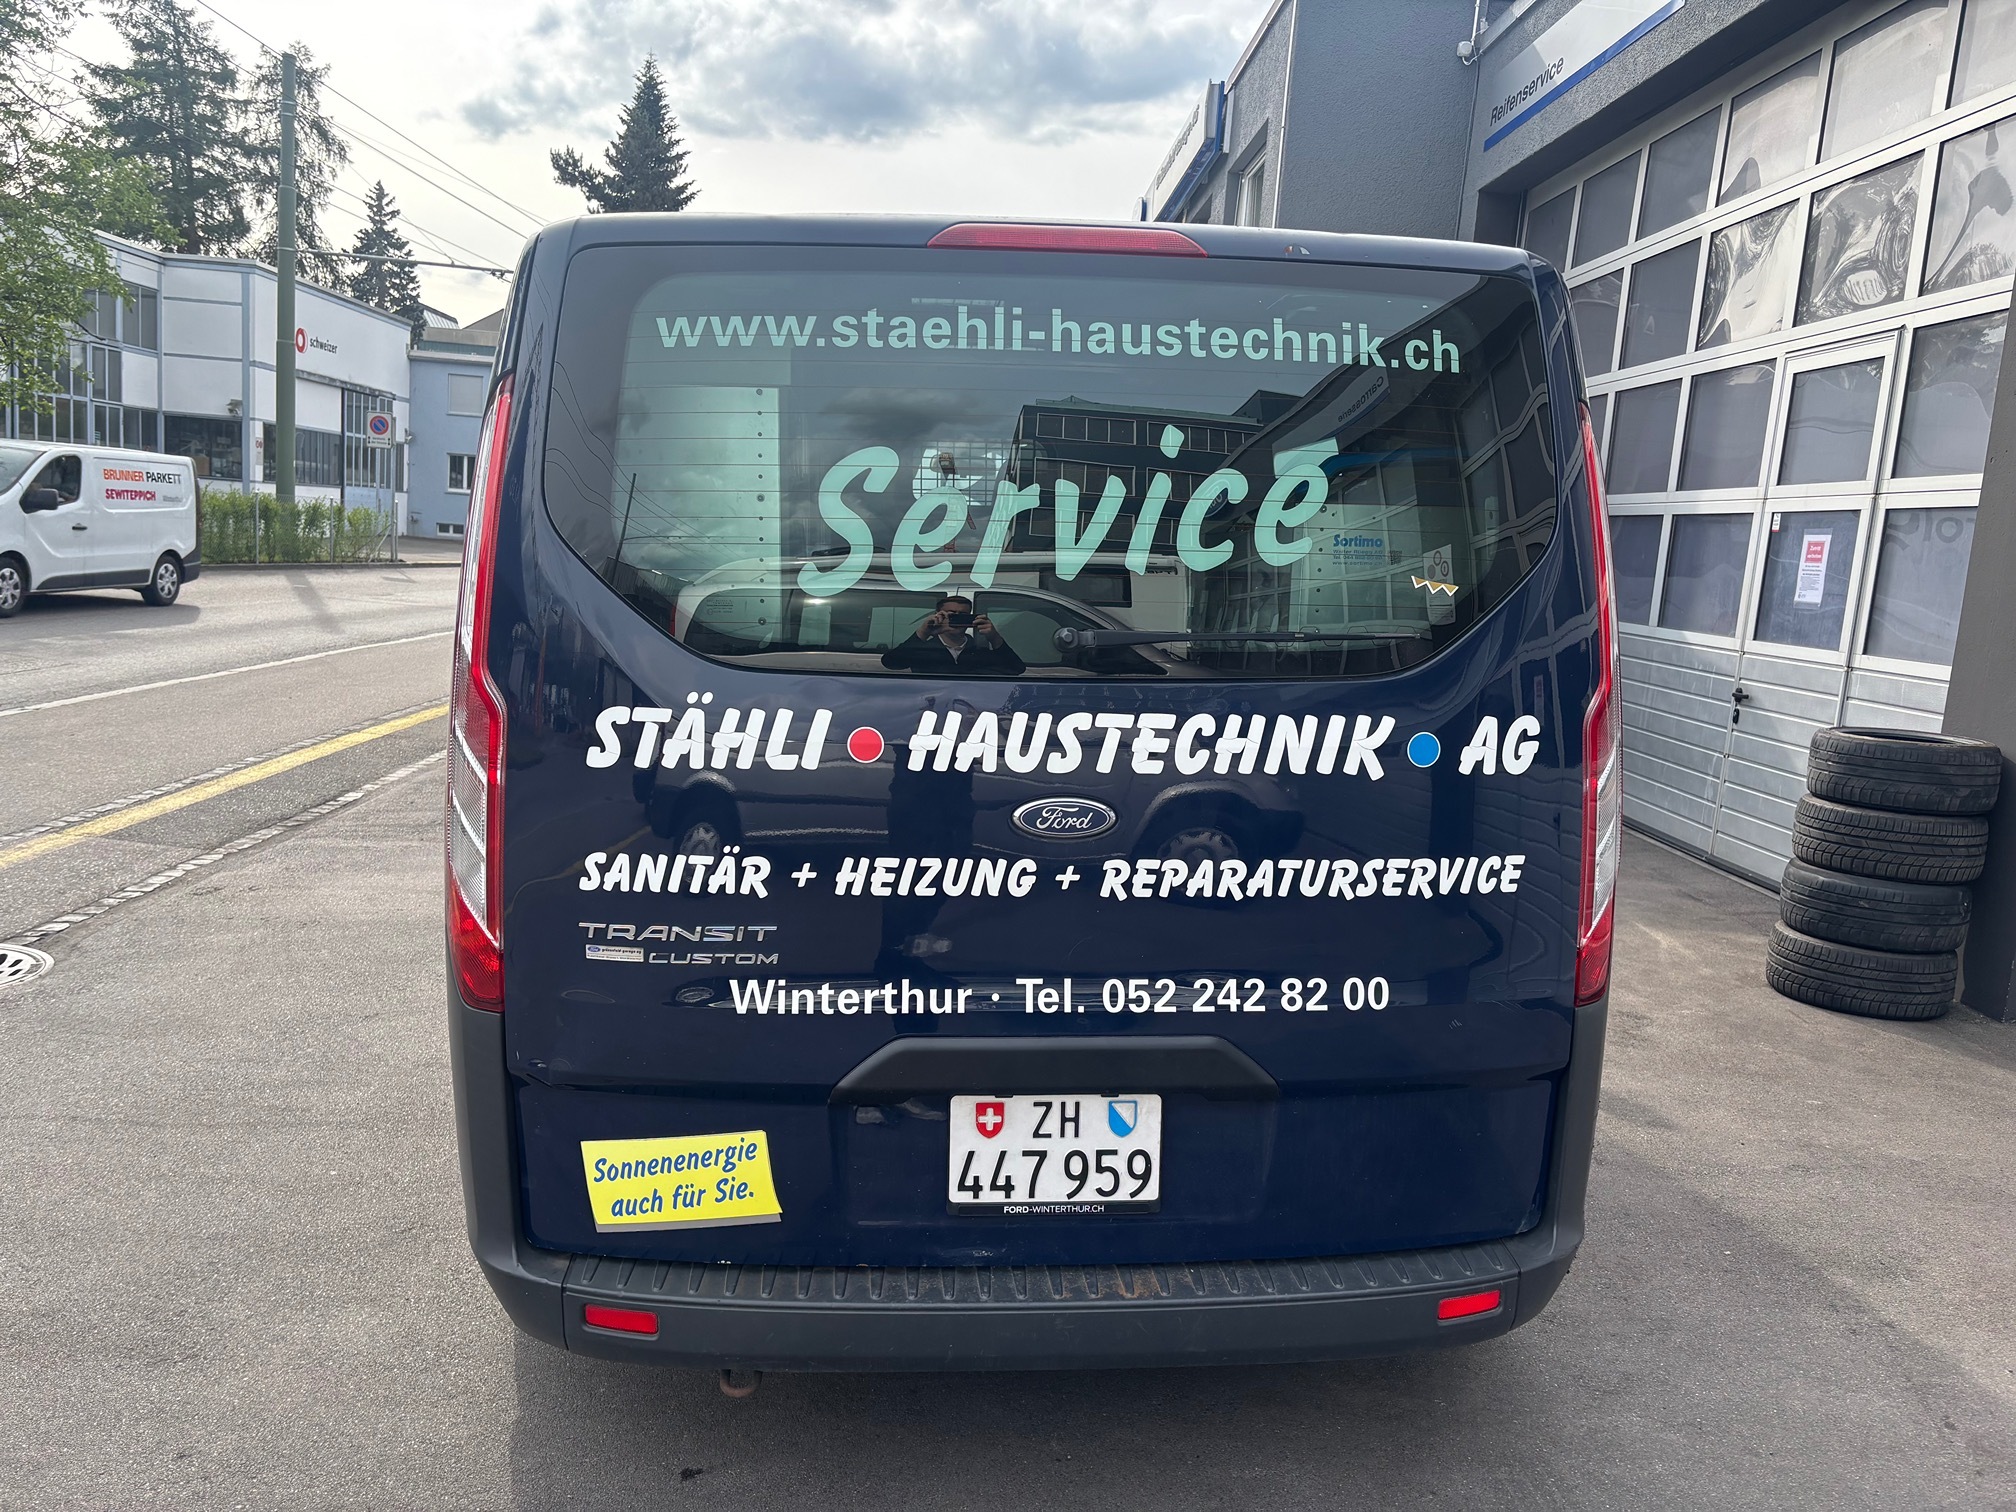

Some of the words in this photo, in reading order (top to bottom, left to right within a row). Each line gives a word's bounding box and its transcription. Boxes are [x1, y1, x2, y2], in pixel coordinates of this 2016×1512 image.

[1490, 57, 1564, 127] Reifenservice
[309, 336, 338, 354] schweizer
[655, 305, 1461, 374] www.staehli-haustechnik.ch
[103, 468, 145, 483] BRUNNER
[145, 471, 182, 485] PARKETT
[105, 488, 157, 501] SEWITEPPICH
[797, 424, 1329, 597] Service
[1333, 534, 1383, 548] Sortimo
[586, 691, 833, 771] STÄHLI
[907, 710, 1396, 781] HAUSTECHNIK
[1458, 714, 1541, 775] AG
[1036, 805, 1094, 830] Ford
[578, 845, 771, 899] SANITÄR
[834, 856, 1037, 898] HEIZUNG
[1099, 854, 1526, 902] REPARATURSERVICE
[578, 921, 778, 942] TRANSIT
[648, 952, 779, 965] CUSTOM
[728, 978, 973, 1015] Winterthur
[1015, 978, 1085, 1014] Tel.
[1102, 978, 1177, 1013] 052
[1192, 978, 1266, 1013] 242
[1280, 977, 1328, 1012] 82
[1343, 976, 1389, 1011] 00
[1032, 1101, 1080, 1138] ZH
[593, 1137, 758, 1183] Sonnenenergie
[957, 1150, 1048, 1199] 447
[1063, 1149, 1152, 1200] 959
[611, 1188, 663, 1217] auch
[672, 1183, 706, 1210] für
[714, 1176, 754, 1203] Sie.
[1003, 1204, 1105, 1214] FORD-WINTERTHUR.CH
